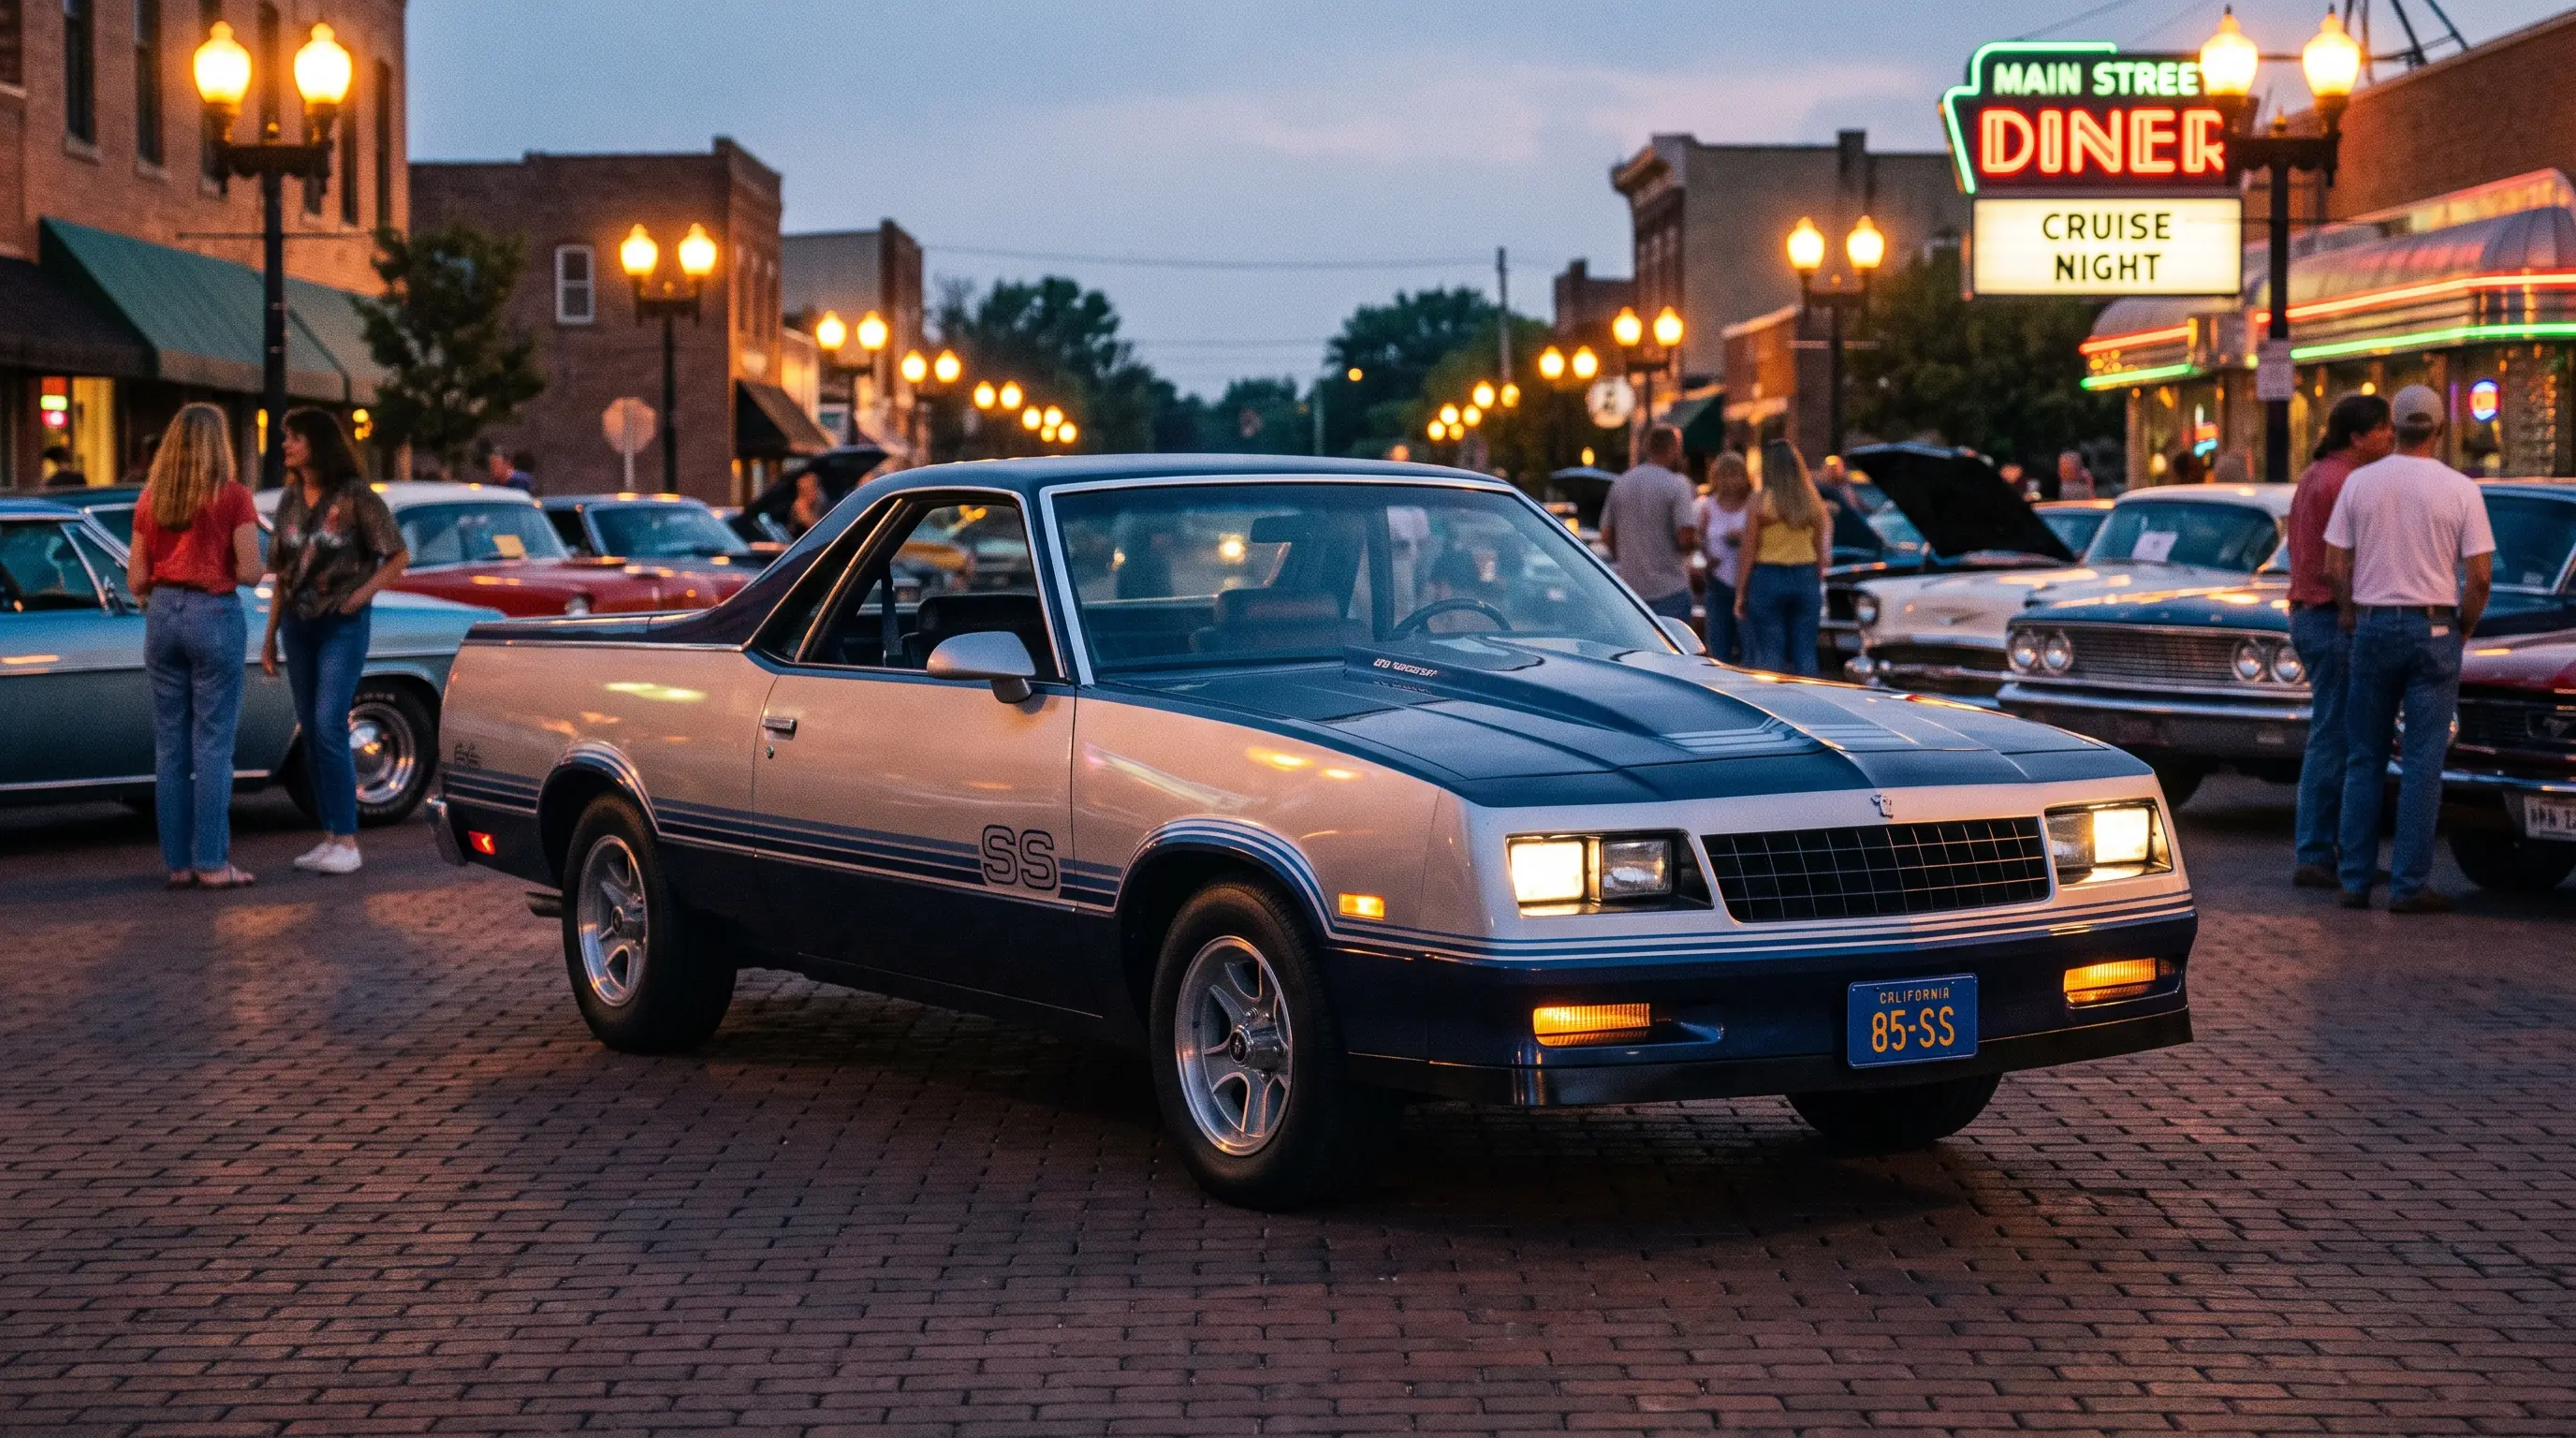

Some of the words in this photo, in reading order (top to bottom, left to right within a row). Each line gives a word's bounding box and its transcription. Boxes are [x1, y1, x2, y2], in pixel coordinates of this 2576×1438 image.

[1993, 62, 2082, 95] MAIN
[2092, 62, 2202, 95] STREE
[1980, 108, 2225, 175] DINER
[2042, 213, 2172, 240] CRUISE
[2055, 254, 2162, 282] NIGHT
[981, 824, 1058, 891] SS
[1880, 987, 1950, 1004] CALIFORNIA
[1871, 1005, 1955, 1053] 85-SS
